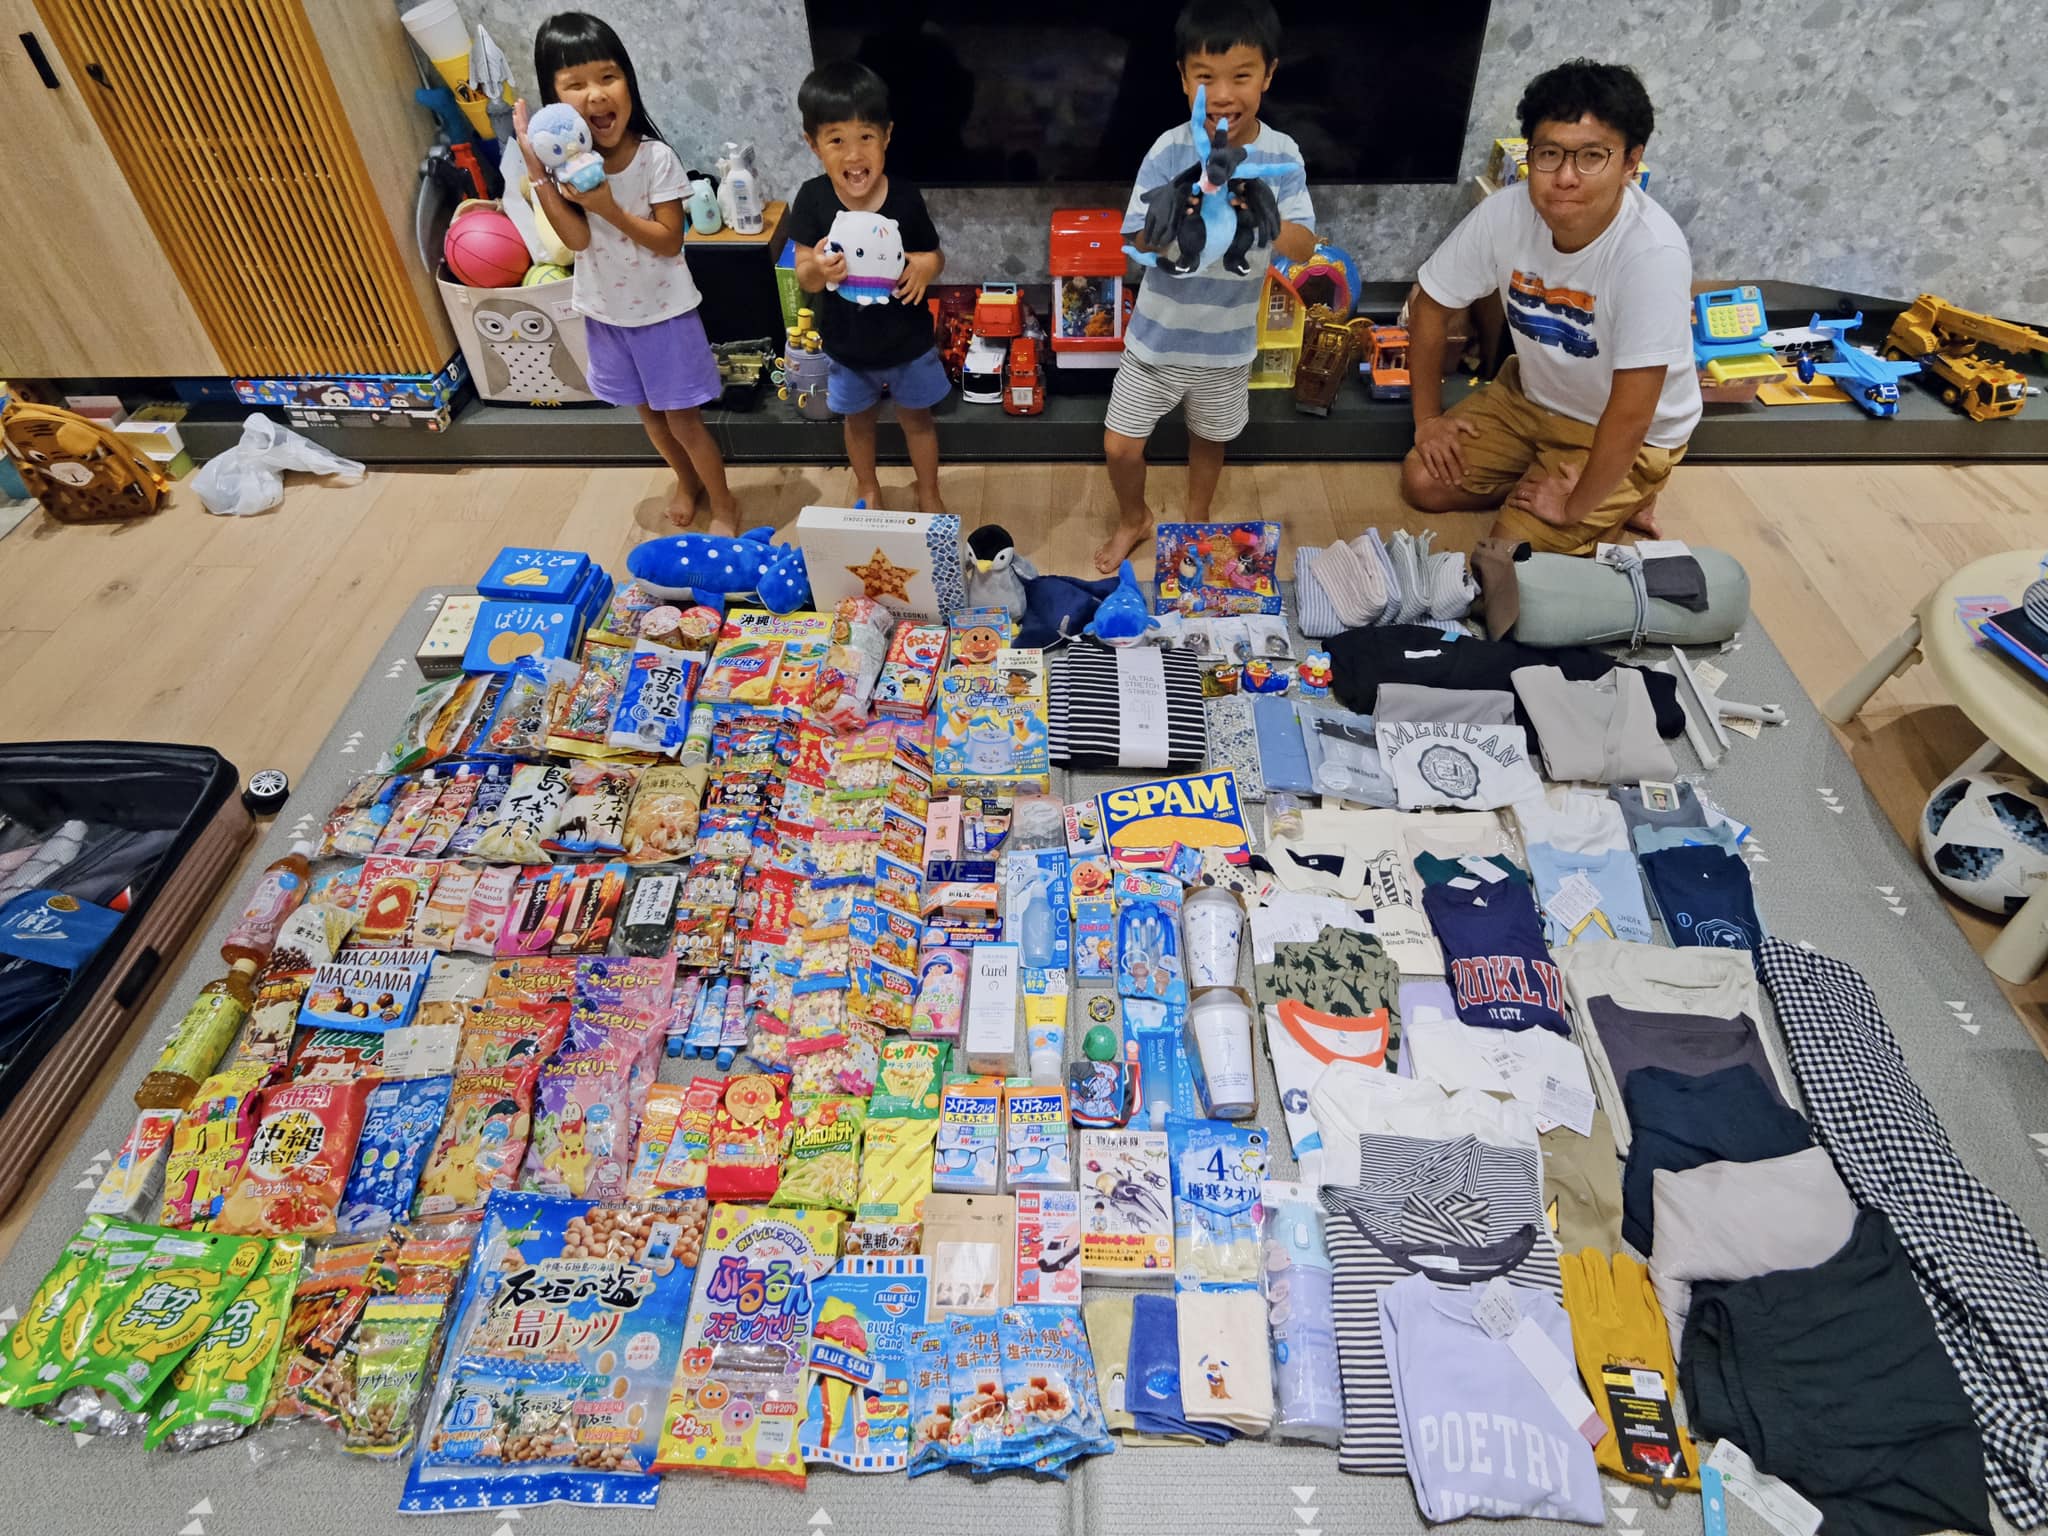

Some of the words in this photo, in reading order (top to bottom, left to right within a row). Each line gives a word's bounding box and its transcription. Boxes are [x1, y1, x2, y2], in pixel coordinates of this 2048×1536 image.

[515, 553, 562, 567] さんど
[495, 609, 549, 632] ぱりん
[907, 631, 943, 645] おっとっと
[650, 666, 682, 718] 雪塩
[1108, 776, 1234, 822] SPAM
[929, 861, 967, 881] EVE
[478, 882, 504, 894] Berry
[1124, 876, 1176, 898] なわとび
[334, 950, 429, 967] MACADAMIA
[316, 966, 414, 992] MACADAMIA
[883, 1043, 940, 1060] じゃがりこ
[1282, 1088, 1309, 1116] G
[279, 1111, 311, 1125] 九州
[250, 1123, 326, 1152] 沖縄
[1188, 1181, 1262, 1202] 極寒タオル
[135, 1281, 201, 1312] 塩分
[498, 1268, 645, 1310] 石垣の塩
[706, 1255, 814, 1316] ぷるるん
[877, 1293, 898, 1304] BLUE
[899, 1293, 918, 1304] SEAL
[119, 1309, 183, 1330] チャージ
[507, 1310, 622, 1350] 島ナッツ
[703, 1311, 809, 1344] スティックゼリー
[866, 1320, 894, 1335] BLUE
[876, 1336, 905, 1352] Cand
[1019, 1328, 1062, 1347] 沖縄
[814, 1347, 845, 1368] BLUE
[845, 1357, 873, 1378] SEAL
[1005, 1342, 1075, 1362] 塩キャラメル
[670, 1416, 714, 1438] 28本入
[1418, 1411, 1572, 1502] POETRY
